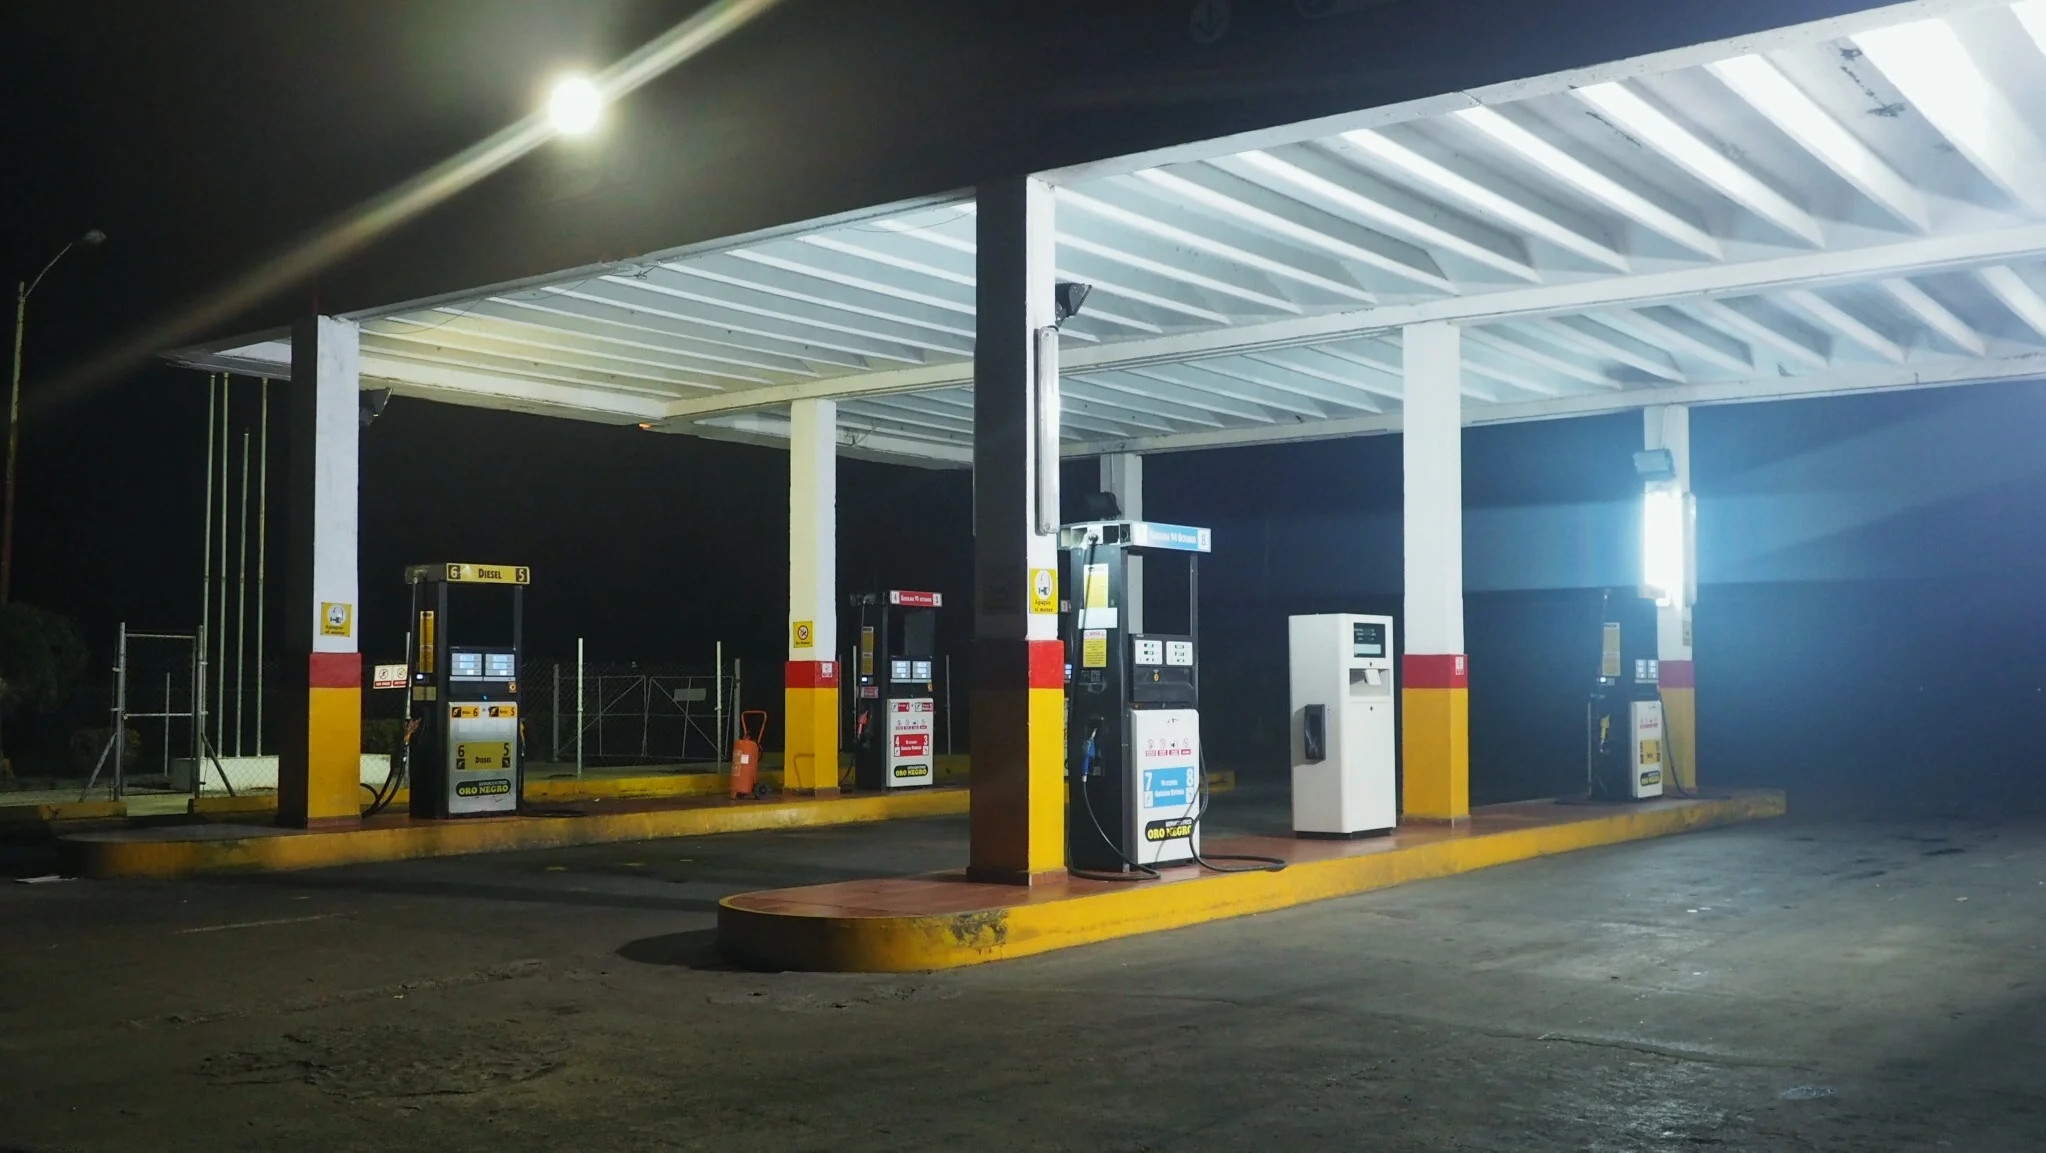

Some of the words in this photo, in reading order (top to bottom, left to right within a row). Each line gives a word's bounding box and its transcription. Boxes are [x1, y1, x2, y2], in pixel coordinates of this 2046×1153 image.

[1201, 533, 1207, 546] 8
[450, 566, 458, 578] 6
[518, 568, 525, 581] 5
[473, 708, 478, 717] 6
[895, 735, 900, 747] 4
[923, 734, 928, 746] 3
[458, 745, 465, 757] 6
[503, 743, 509, 756] 5
[895, 769, 907, 777] ORO
[907, 768, 927, 776] NEGRO
[1186, 767, 1193, 787] 8
[1144, 771, 1153, 791] 7
[459, 786, 477, 795] ORO
[479, 784, 509, 794] NEGRO
[1147, 827, 1166, 839] ORO
